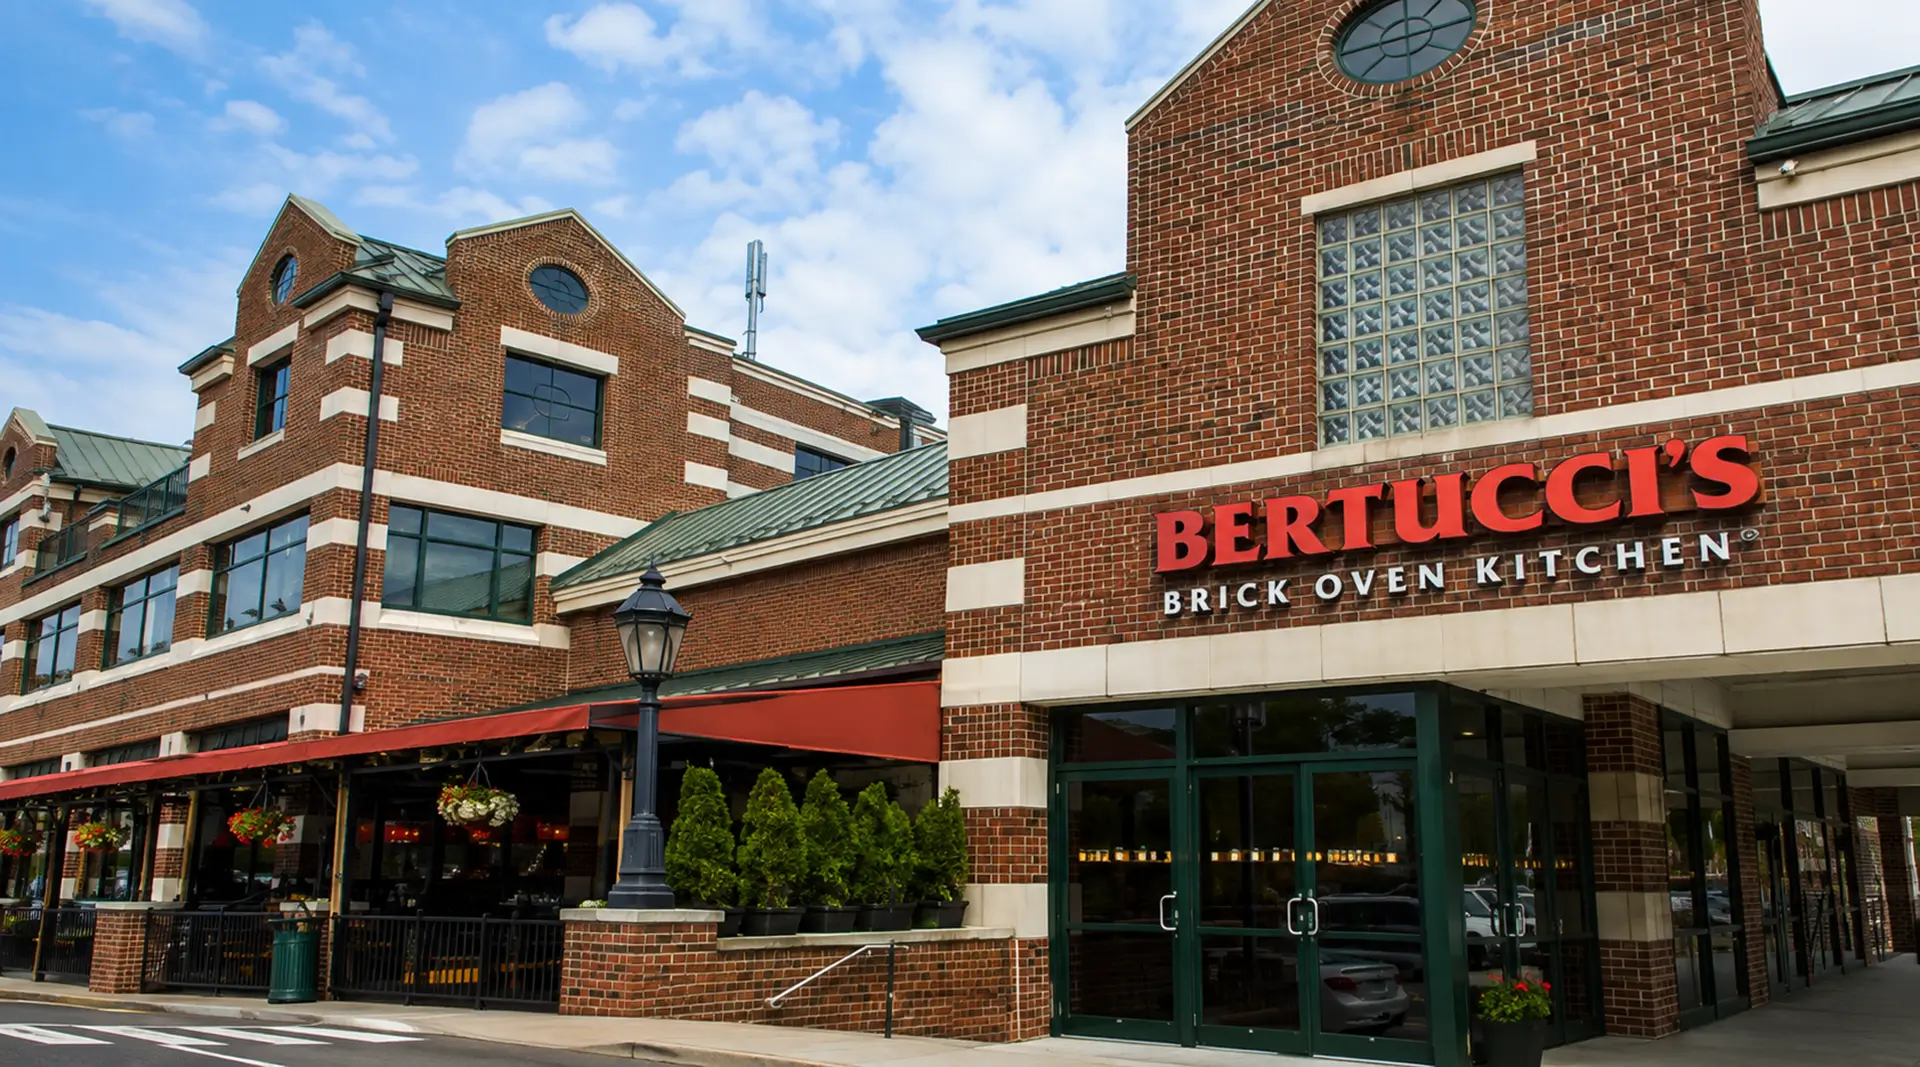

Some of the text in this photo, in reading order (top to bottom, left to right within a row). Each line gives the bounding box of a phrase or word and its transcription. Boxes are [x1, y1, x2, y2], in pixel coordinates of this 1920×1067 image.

[1155, 435, 1761, 573] BERTUCCI'S
[1164, 532, 1731, 615] BRICK OVEN KITCHEN
